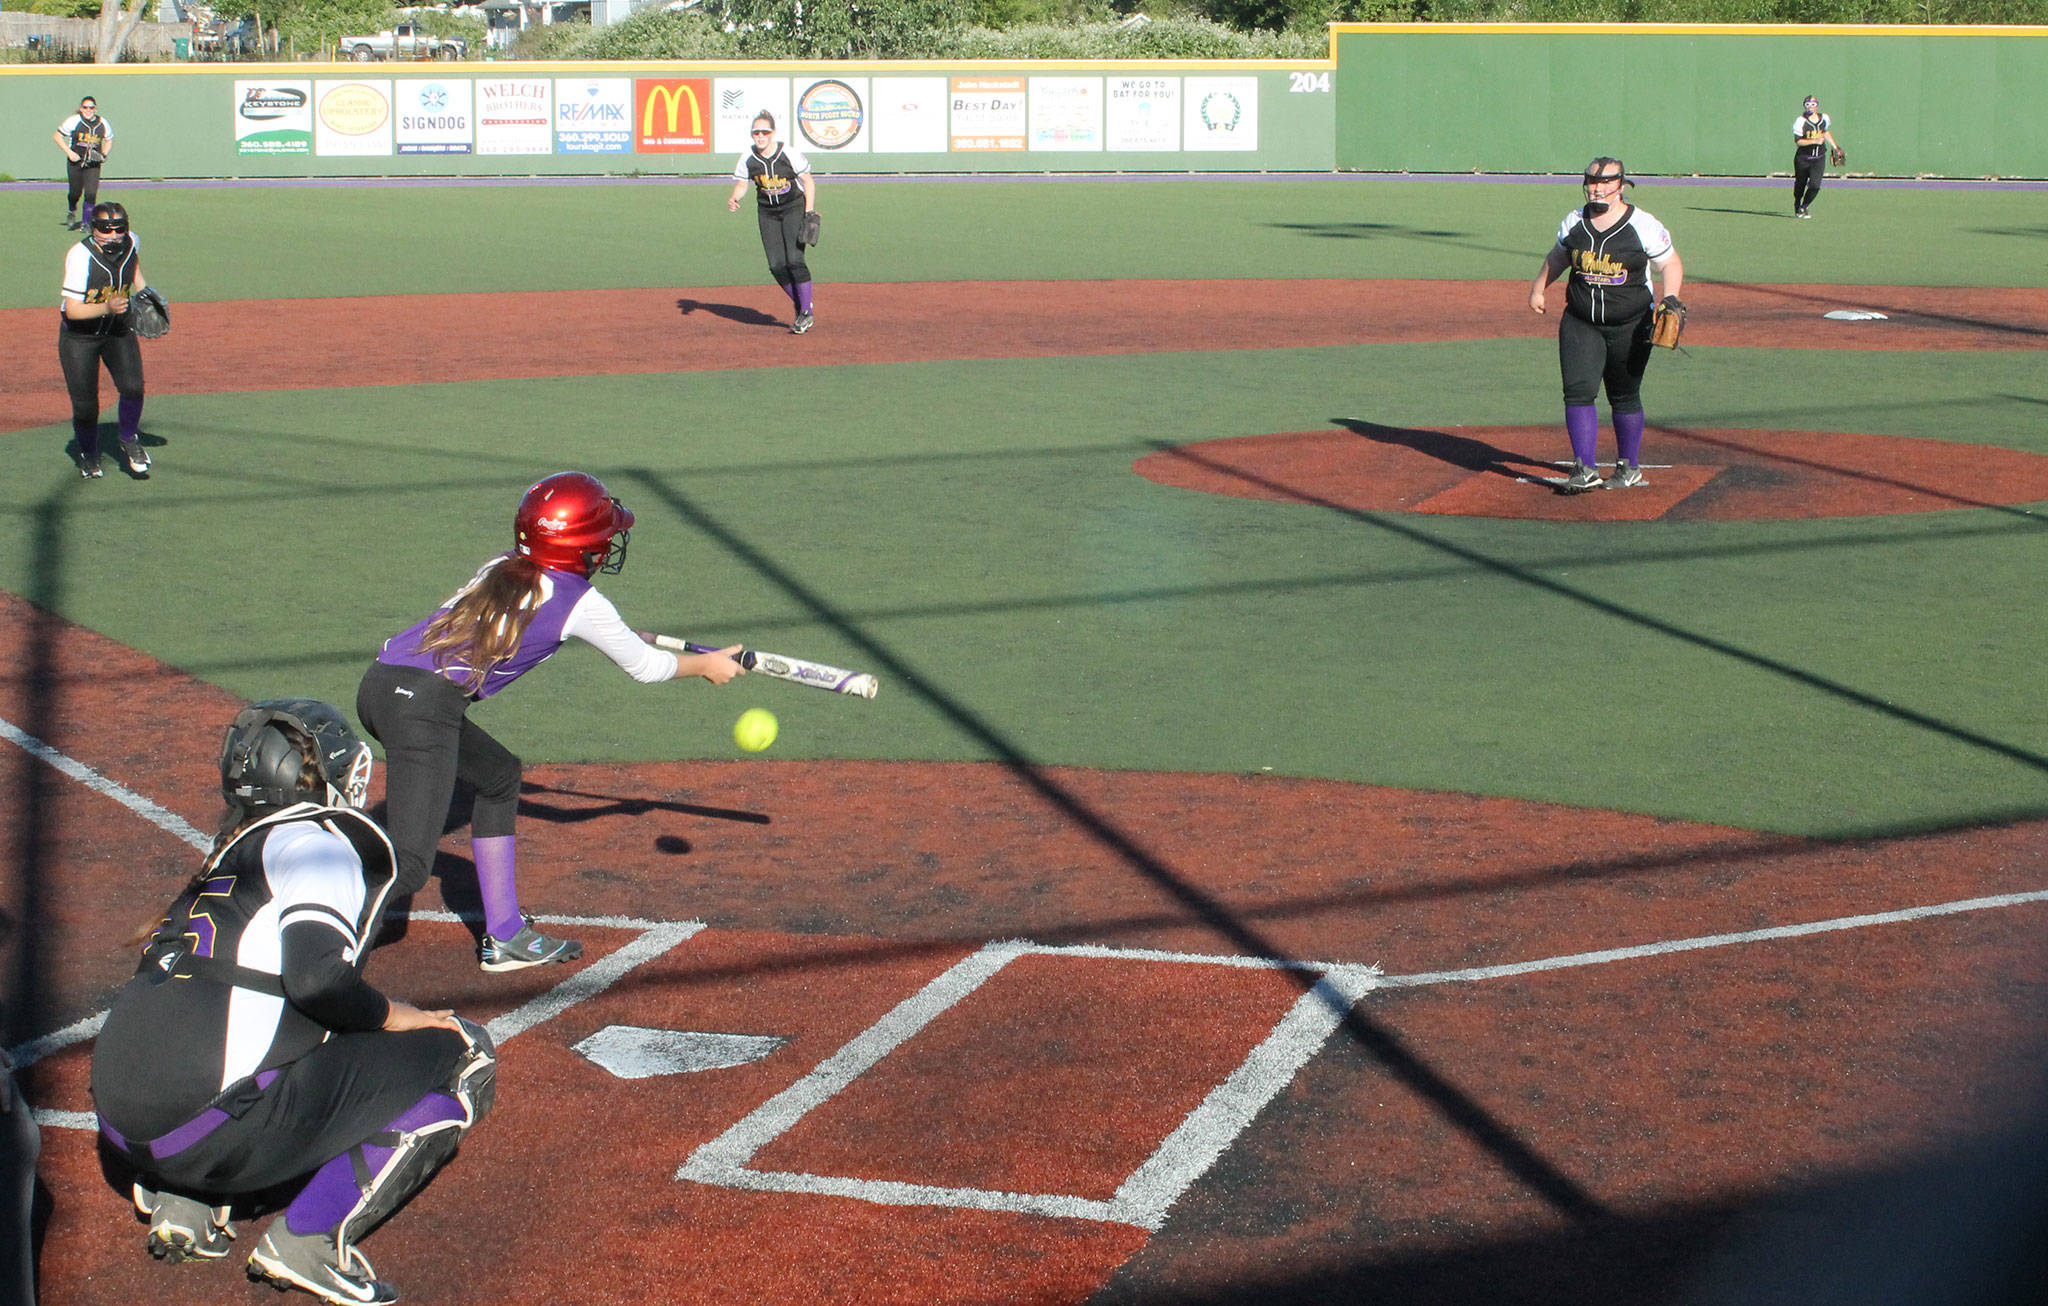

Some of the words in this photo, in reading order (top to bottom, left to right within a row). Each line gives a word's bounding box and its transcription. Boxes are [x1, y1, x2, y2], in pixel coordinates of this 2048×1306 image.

[1122, 81, 1135, 89] WE
[1139, 81, 1151, 89] GO
[1155, 81, 1166, 89] TO
[1289, 72, 1330, 93] 204
[481, 83, 545, 99] WELCH
[1113, 90, 1130, 98] BAT
[1133, 90, 1150, 98] FOR
[485, 101, 542, 113] BROTHERS
[557, 102, 625, 121] RE/MAX
[952, 99, 988, 111] BEST
[402, 116, 466, 130] SIGNDOG
